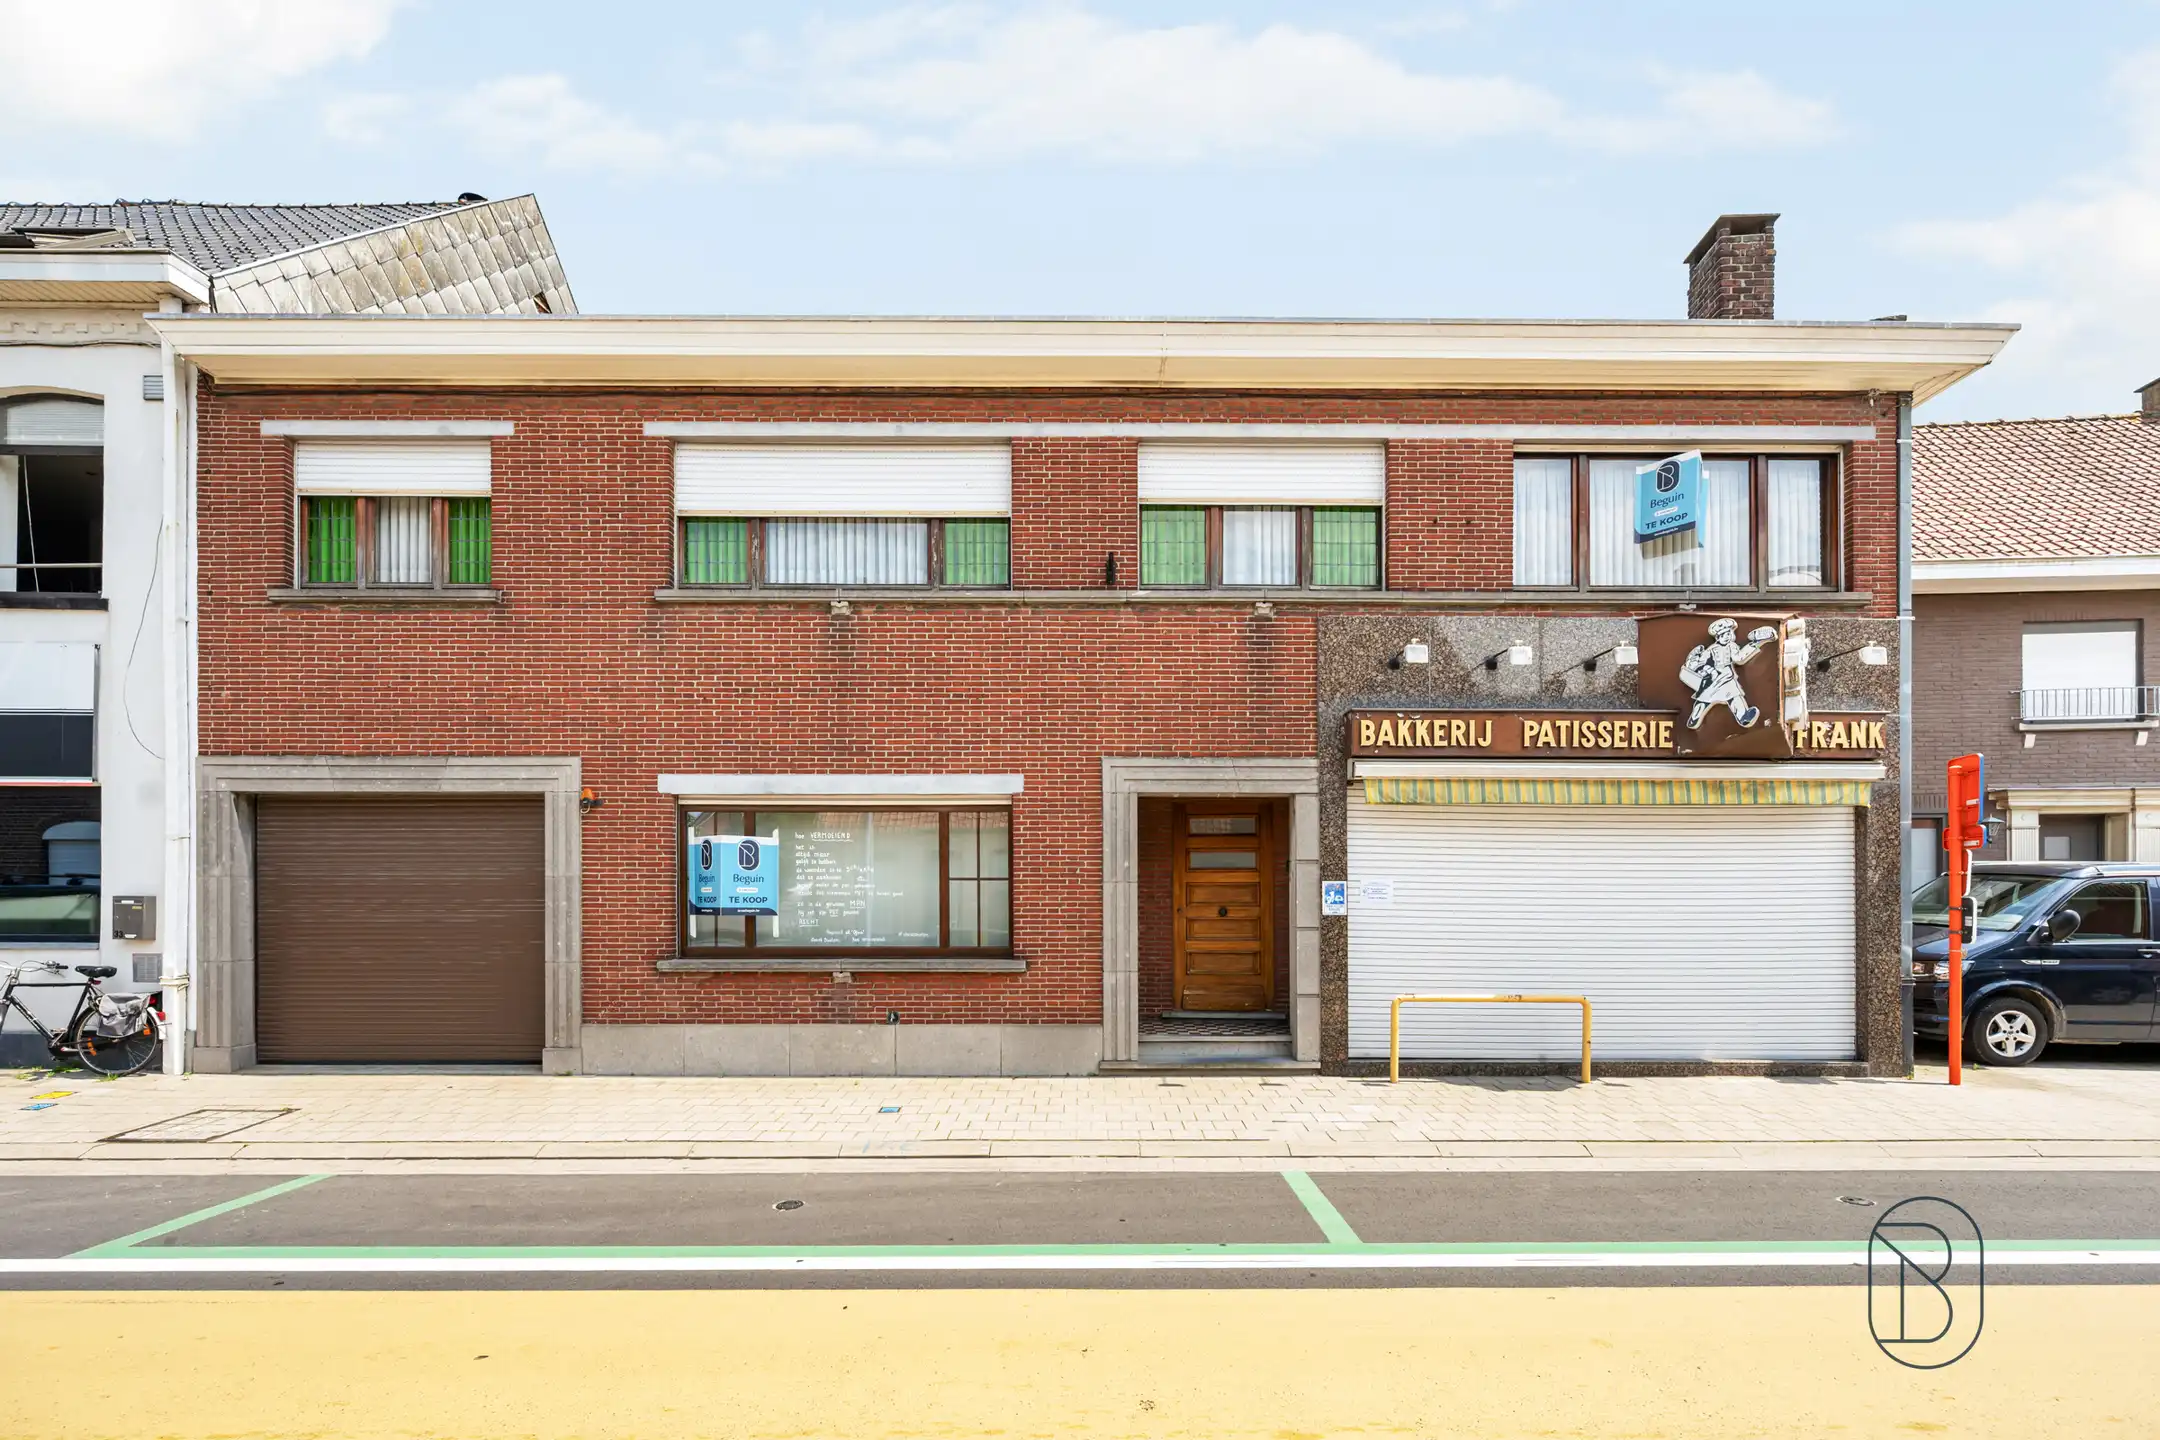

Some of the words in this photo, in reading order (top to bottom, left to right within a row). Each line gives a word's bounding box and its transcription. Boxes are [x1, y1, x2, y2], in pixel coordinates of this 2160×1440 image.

[1650, 493, 1685, 508] Beguin
[1645, 521, 1657, 530] TE
[1660, 512, 1688, 526] KOOP
[1360, 719, 1493, 747] BAKKERIJ
[1523, 720, 1674, 748] PATISSERIE
[1795, 720, 1886, 749] FRANK
[698, 873, 716, 885] Beguin
[732, 873, 765, 885] Beguin
[729, 896, 740, 904] TE
[742, 896, 768, 904] KOOP
[113, 930, 124, 938] 33
